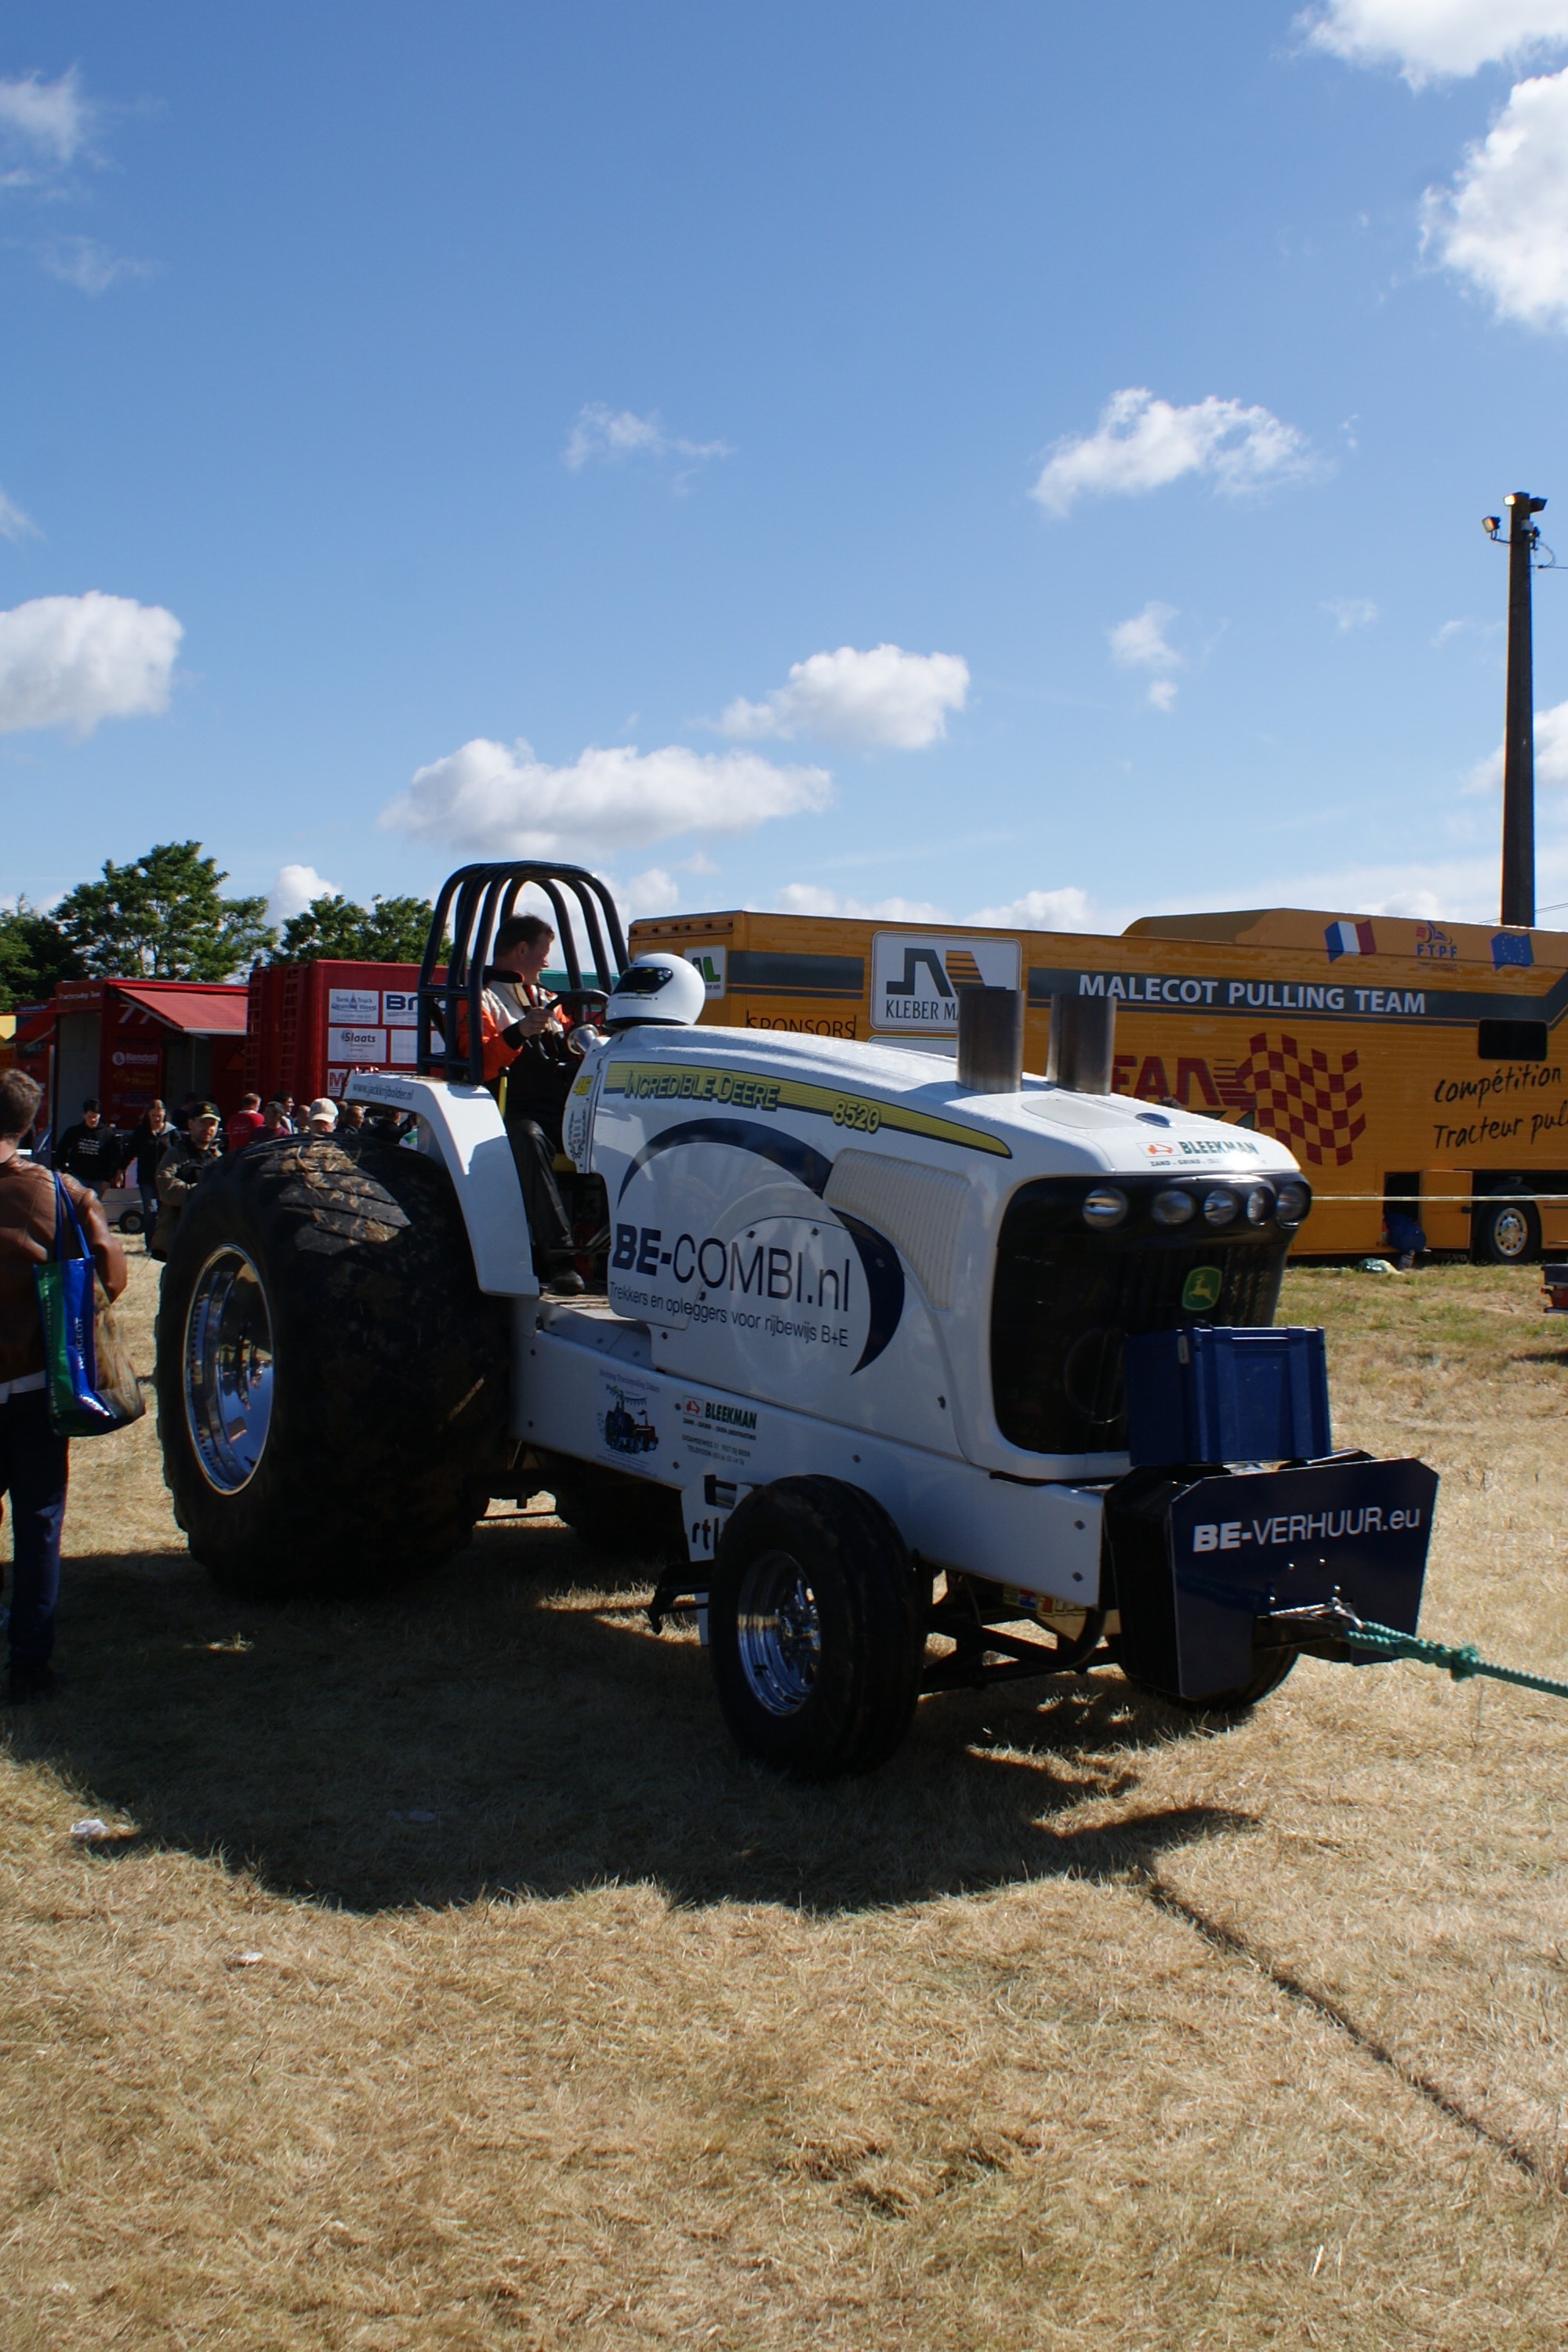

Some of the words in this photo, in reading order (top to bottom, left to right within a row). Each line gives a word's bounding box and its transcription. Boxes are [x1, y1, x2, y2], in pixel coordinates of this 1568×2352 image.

[885, 1000, 939, 1020] KLEBER
[1079, 974, 1218, 1004] MALECOT
[1229, 982, 1345, 1010] PULLING
[1354, 989, 1426, 1014] TEAM
[748, 1017, 855, 1039] SPONSORS
[832, 1099, 882, 1134] 8520
[1433, 1116, 1524, 1149] Tracteur
[1178, 1141, 1259, 1155] BLEEKMAN
[612, 1223, 850, 1312] BE-COMBI.nl
[610, 1281, 648, 1307] Trekkers
[651, 1294, 663, 1309] en
[666, 1297, 728, 1323] opleggers
[731, 1311, 762, 1330] voor
[764, 1315, 816, 1344] rijbewijs
[821, 1325, 849, 1347] B+E
[705, 1402, 757, 1429] BLEEKMAN
[1192, 1506, 1421, 1553] BE-VERHUUR.eu
